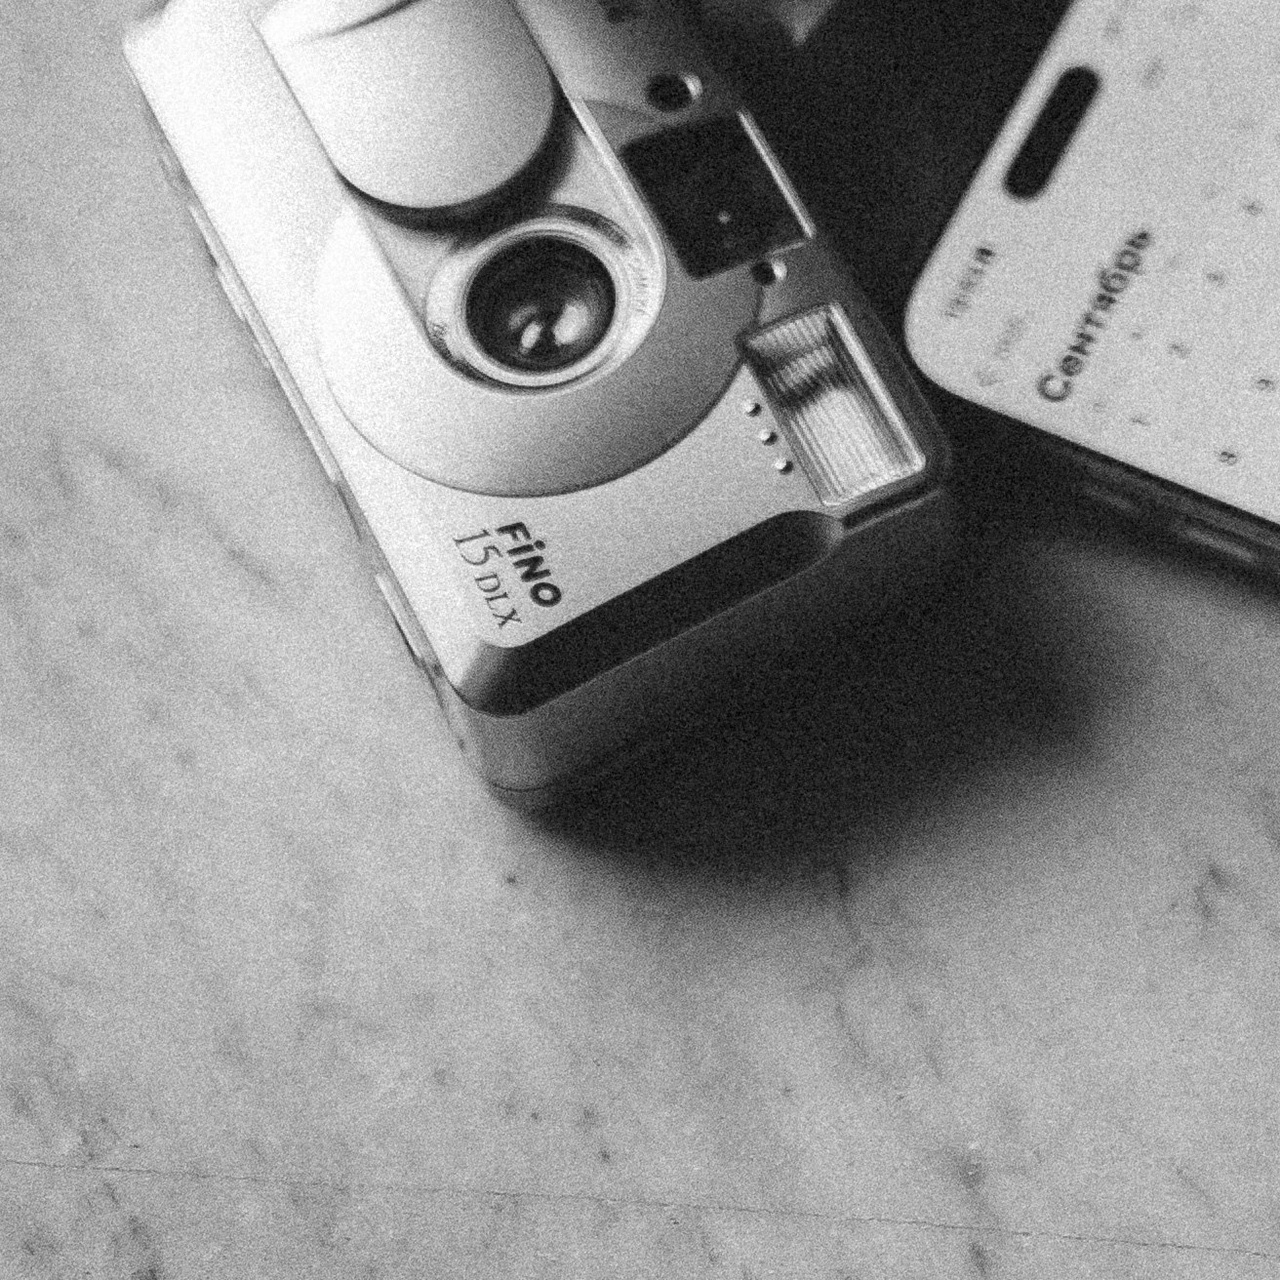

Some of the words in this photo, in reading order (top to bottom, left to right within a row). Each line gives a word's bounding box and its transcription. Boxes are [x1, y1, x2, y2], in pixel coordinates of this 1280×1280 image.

[1038, 229, 1155, 402] Сентябрь
[452, 528, 504, 566] 15
[474, 571, 523, 629] DLX
